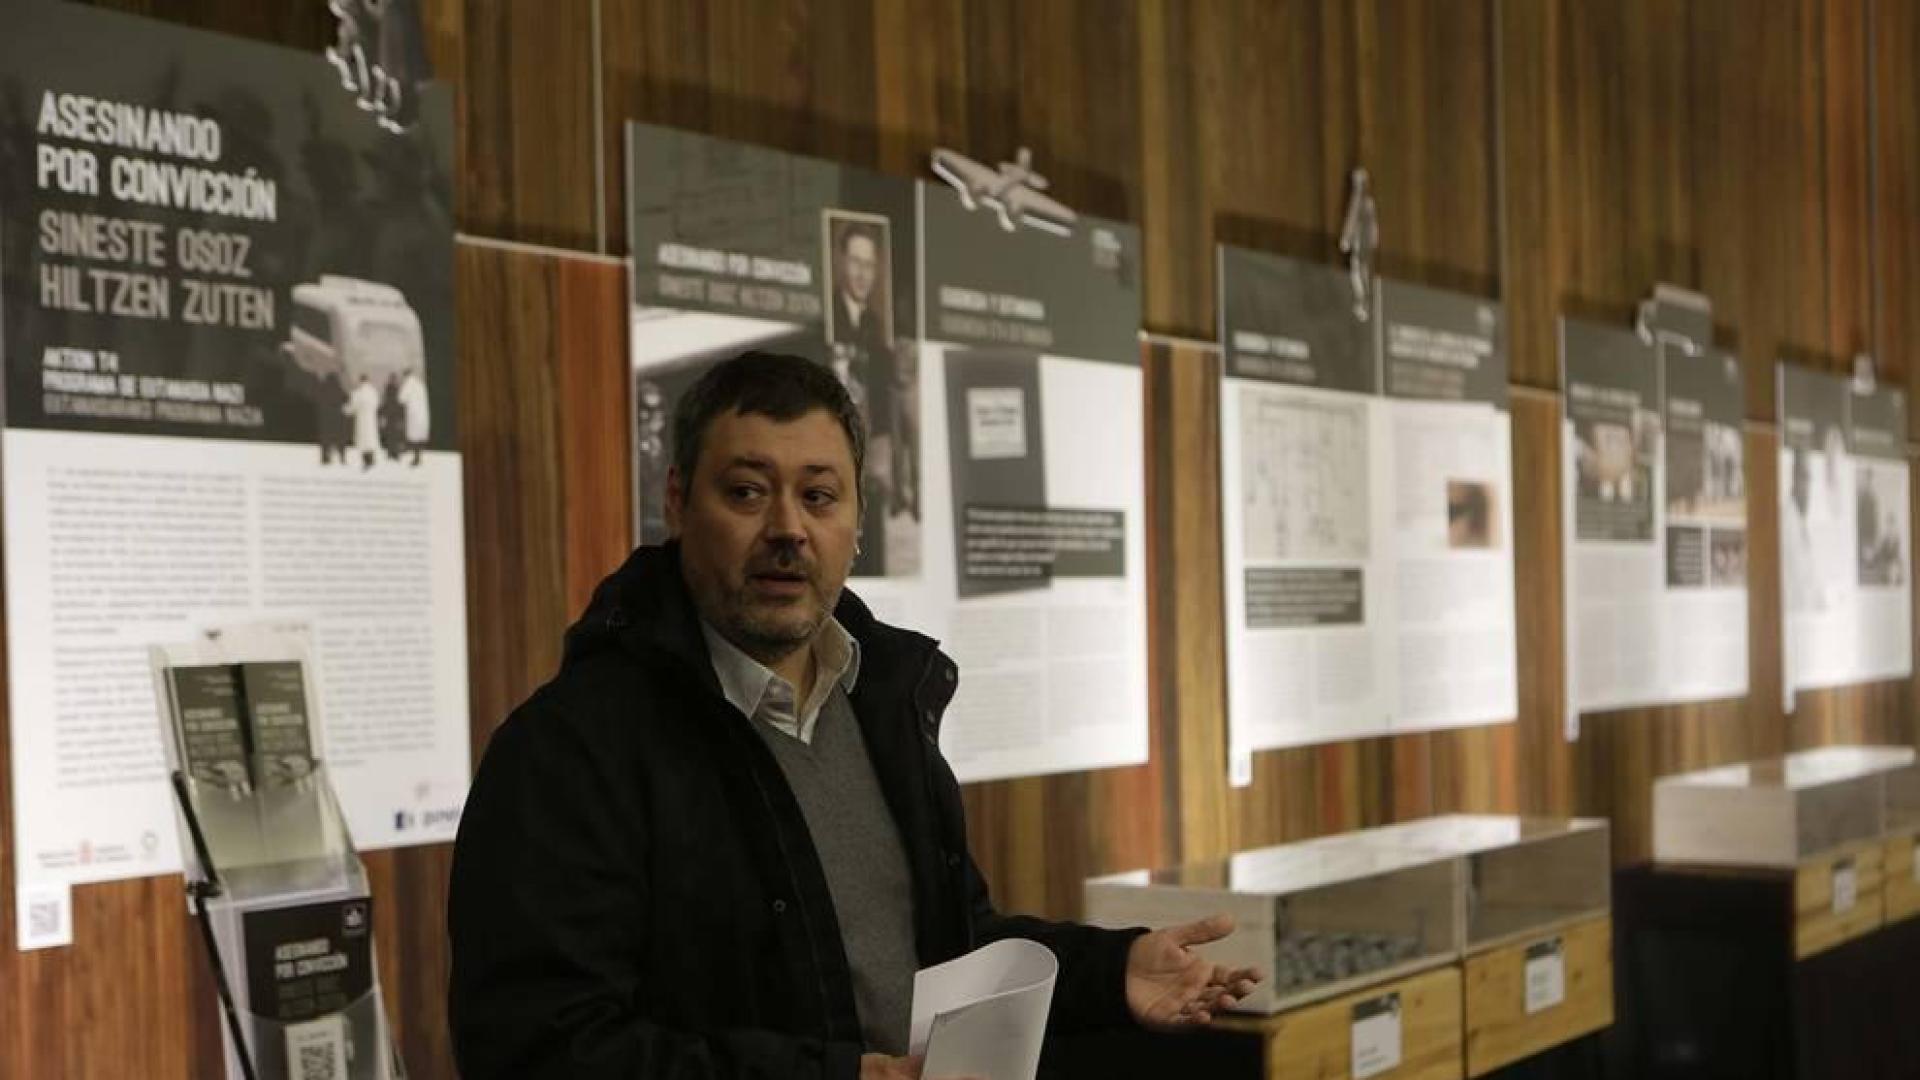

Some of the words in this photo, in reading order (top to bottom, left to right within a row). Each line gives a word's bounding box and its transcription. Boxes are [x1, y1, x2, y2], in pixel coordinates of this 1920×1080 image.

[37, 90, 221, 161] ASESINANDO
[37, 143, 98, 196] POR
[111, 154, 277, 221] CONVICCIÓN
[39, 209, 167, 267] SINESTE
[176, 227, 253, 277] OSOZ
[40, 263, 169, 319] HILTZEN
[181, 279, 275, 330] ZUTEN
